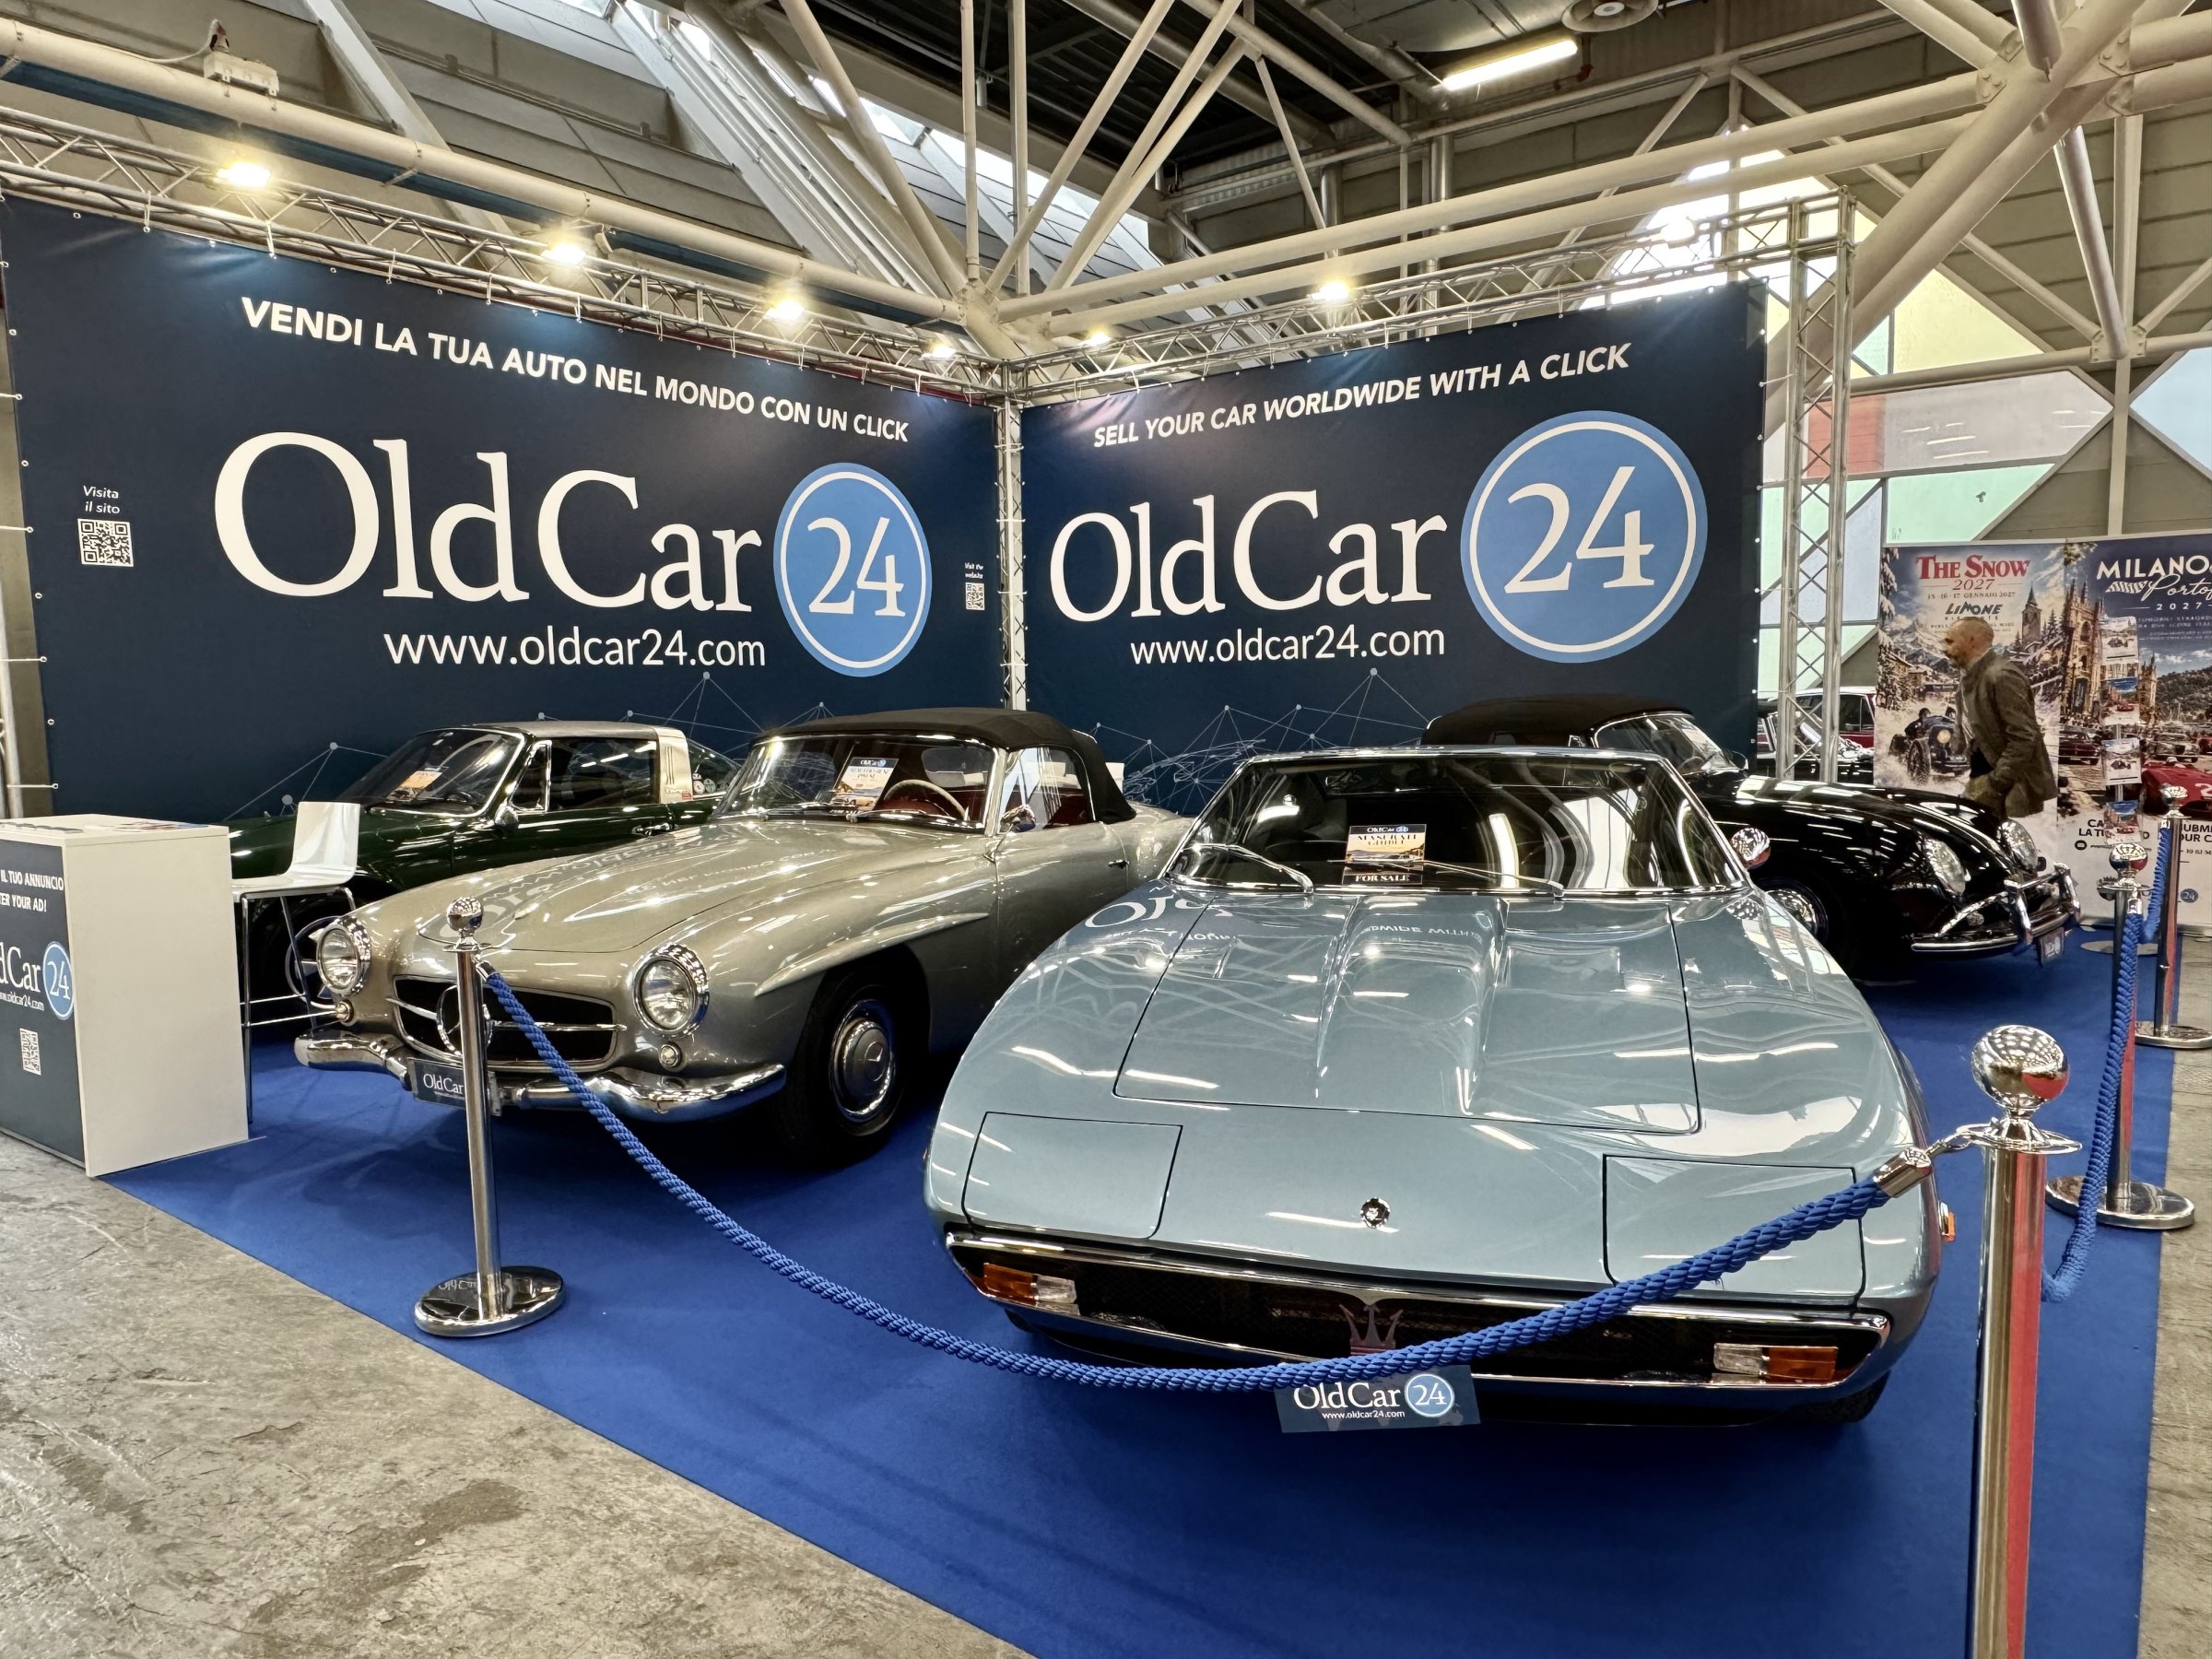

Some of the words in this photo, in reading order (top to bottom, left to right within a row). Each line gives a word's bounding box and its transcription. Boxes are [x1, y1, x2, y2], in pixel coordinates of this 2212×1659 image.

[241, 297, 363, 347] VENDI
[375, 323, 418, 356] LA
[428, 332, 494, 370] TUA
[501, 347, 587, 384] AUTO
[594, 363, 648, 396] NEL
[654, 381, 755, 415] MONDO
[760, 395, 811, 425] CON
[817, 406, 848, 431] UN
[853, 414, 909, 442] CLICK
[1093, 419, 1140, 448] SELL
[1145, 411, 1206, 441] YOUR
[1210, 403, 1257, 429] CAR
[1263, 376, 1422, 422] WORLDWIDE
[1430, 365, 1502, 396] WITH
[1508, 359, 1531, 385] A
[1540, 342, 1632, 380] CLICK
[83, 485, 119, 499] Visita
[85, 500, 93, 512] il
[96, 502, 121, 514] sito
[1503, 465, 1656, 594] 24
[806, 515, 906, 618] 24
[1916, 555, 1960, 579] THE
[1964, 555, 2030, 579] SNOW
[2097, 555, 2209, 580] MILANO
[1952, 578, 1995, 591] 2027
[2156, 602, 2202, 611] 2027
[383, 625, 765, 666] www.oldcar24.com
[1130, 624, 1444, 665] www.oldcar24.com
[2180, 834, 2201, 842] OUR
[8, 870, 24, 886] TUO
[24, 872, 65, 891] ANNUNCIO
[12, 894, 32, 910] YOUR
[33, 897, 47, 912] AD!
[47, 960, 71, 1000] 24
[1412, 1382, 1448, 1406] 24
[1322, 1410, 1406, 1419] www.oldcar24.com
